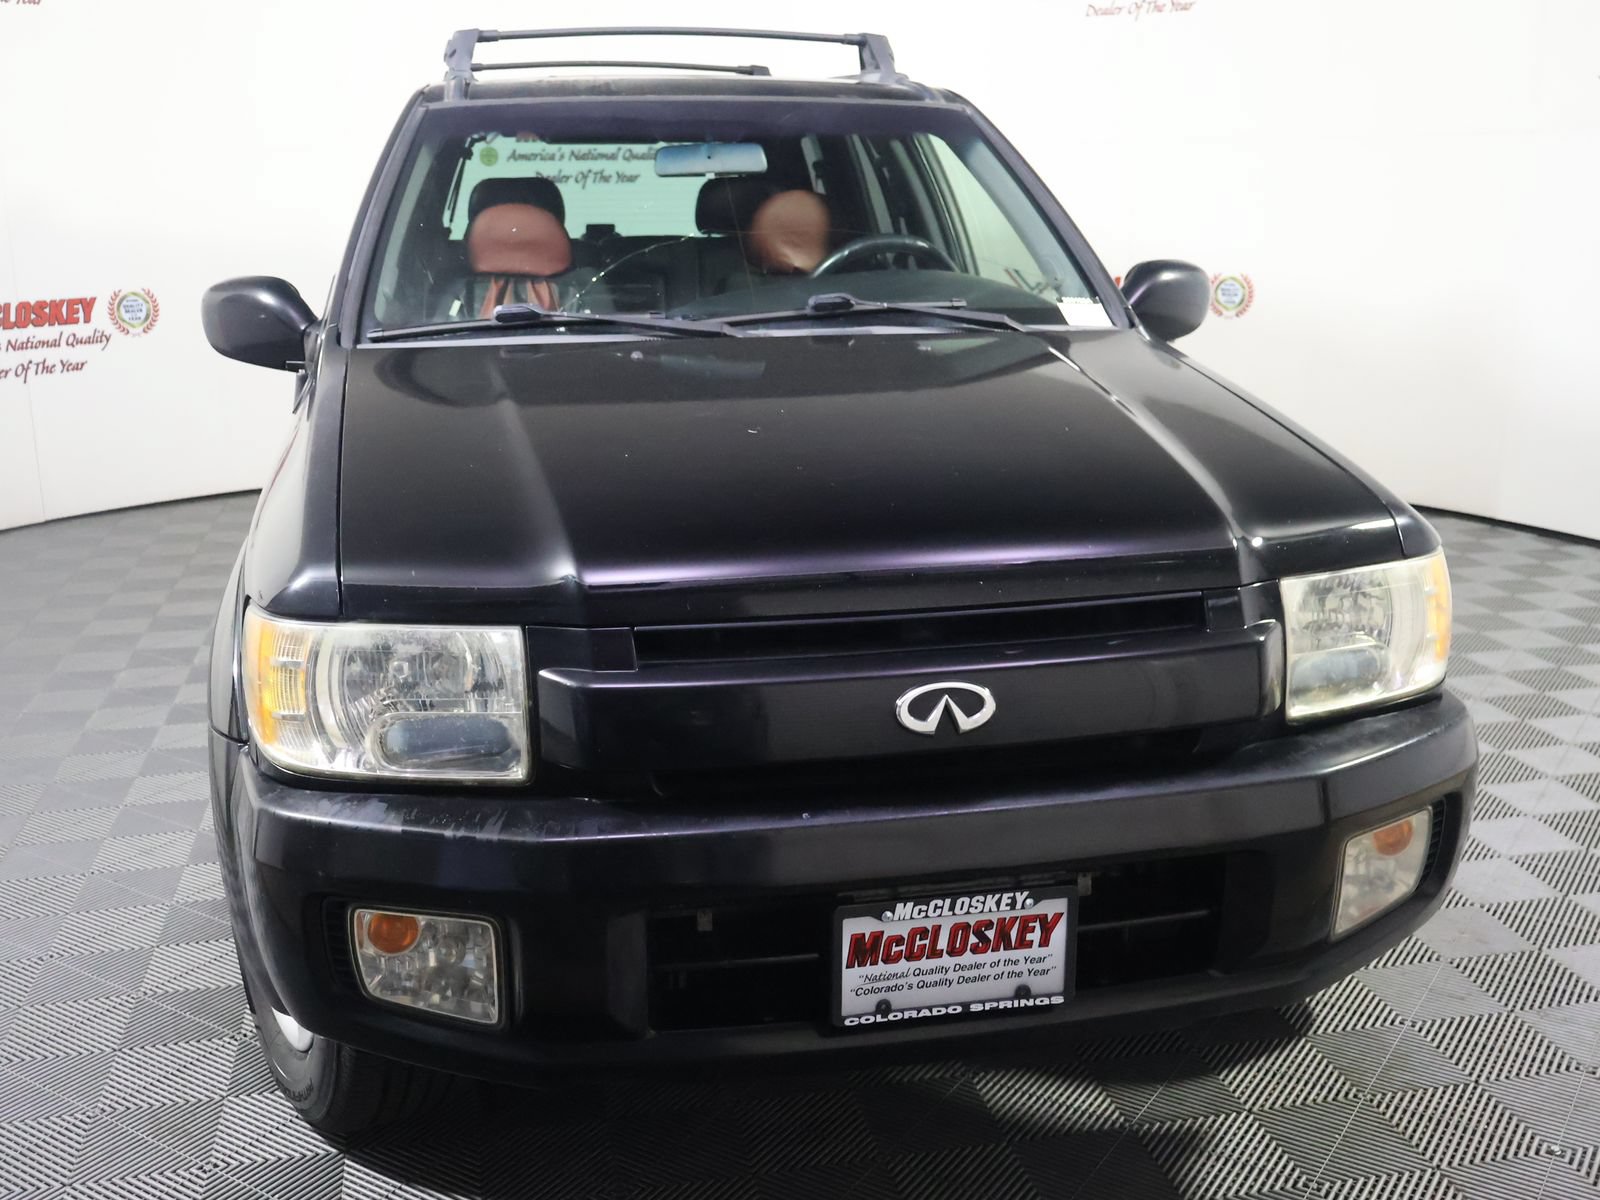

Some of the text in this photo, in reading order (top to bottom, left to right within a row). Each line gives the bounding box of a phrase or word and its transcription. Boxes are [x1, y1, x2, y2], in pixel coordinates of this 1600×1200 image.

[568, 146, 622, 161] National
[574, 169, 592, 190] Of
[592, 169, 612, 183] The
[614, 170, 640, 184] Year
[0, 296, 97, 330] LOSKEY
[5, 331, 63, 352] National
[65, 328, 112, 351] Quality
[14, 360, 32, 385] Of
[34, 358, 56, 376] The
[59, 359, 87, 374] Year
[893, 890, 1030, 921] McCLOSKEY
[845, 912, 1065, 970] McCLOSKEY
[912, 964, 951, 977] Quality
[952, 961, 987, 973] Dealer
[989, 958, 1001, 969] of
[1003, 957, 1020, 967] the
[916, 977, 955, 989] Quality
[956, 974, 991, 985] Dealer
[993, 970, 1005, 981] of
[1006, 969, 1024, 979] the
[844, 995, 1065, 1026] COLORADO SPRINGS
